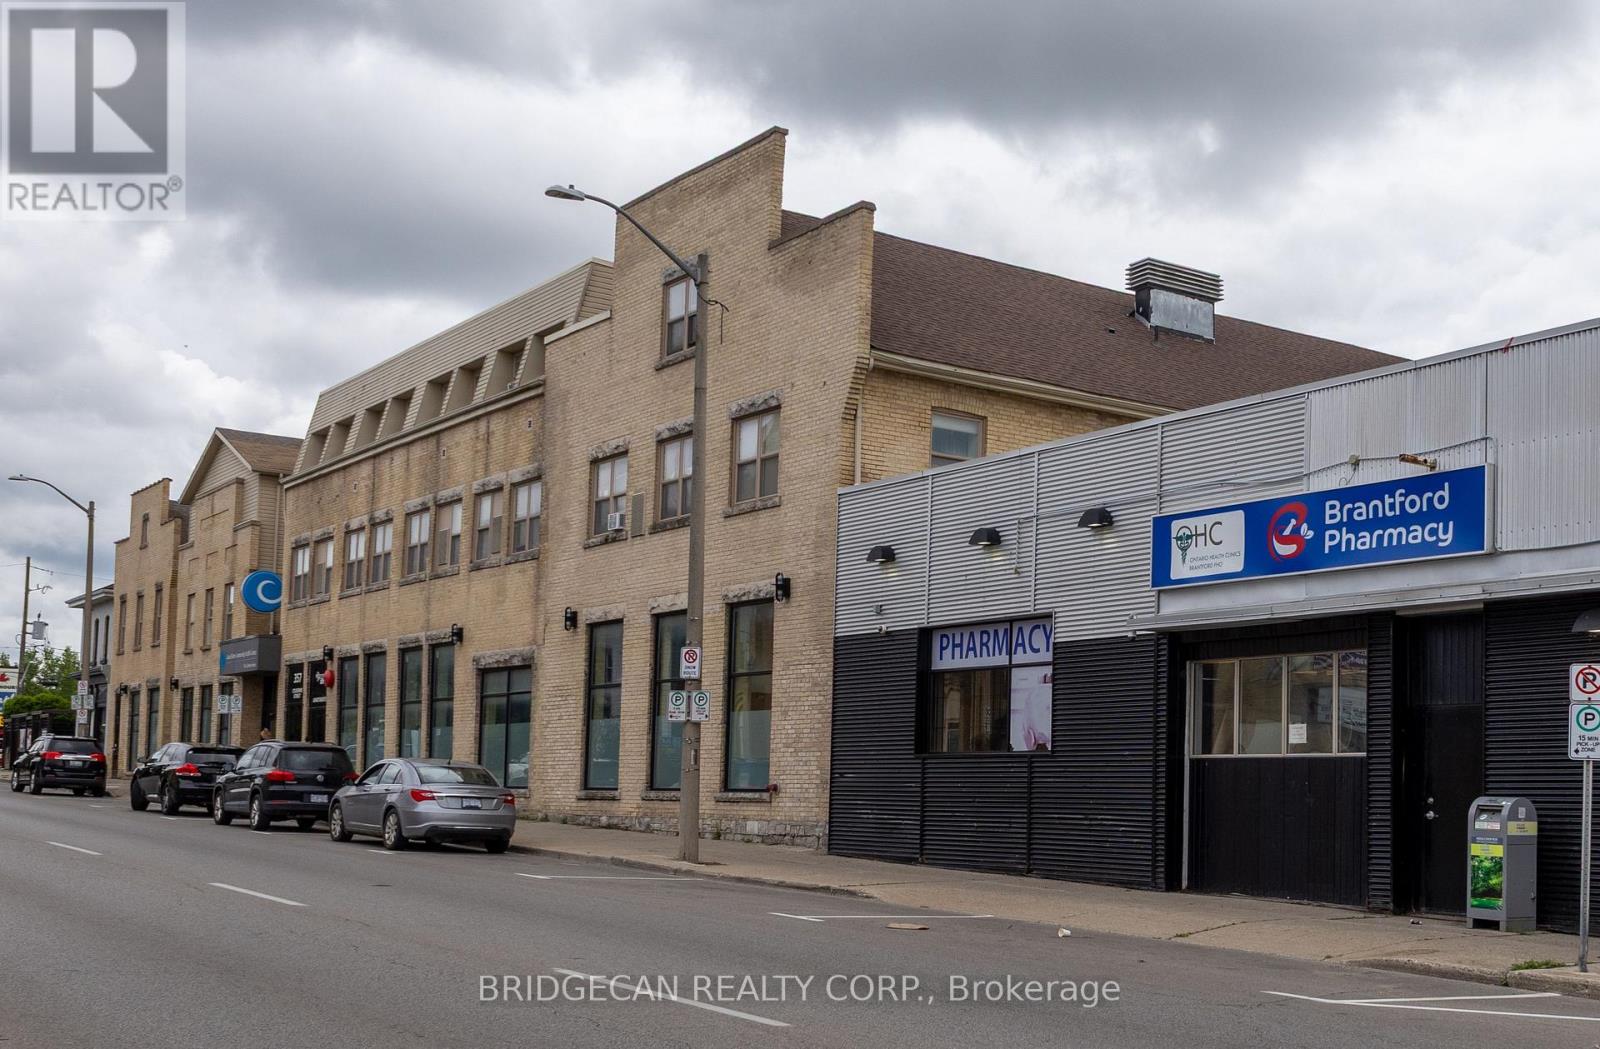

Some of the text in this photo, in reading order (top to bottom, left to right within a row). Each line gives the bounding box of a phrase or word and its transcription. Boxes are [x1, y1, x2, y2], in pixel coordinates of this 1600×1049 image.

[1324, 481, 1449, 525] Brantford
[1175, 520, 1223, 551] OHC
[1324, 520, 1454, 554] Pharmacy
[939, 623, 1053, 661] PHARMACY
[1584, 712, 1596, 726] P
